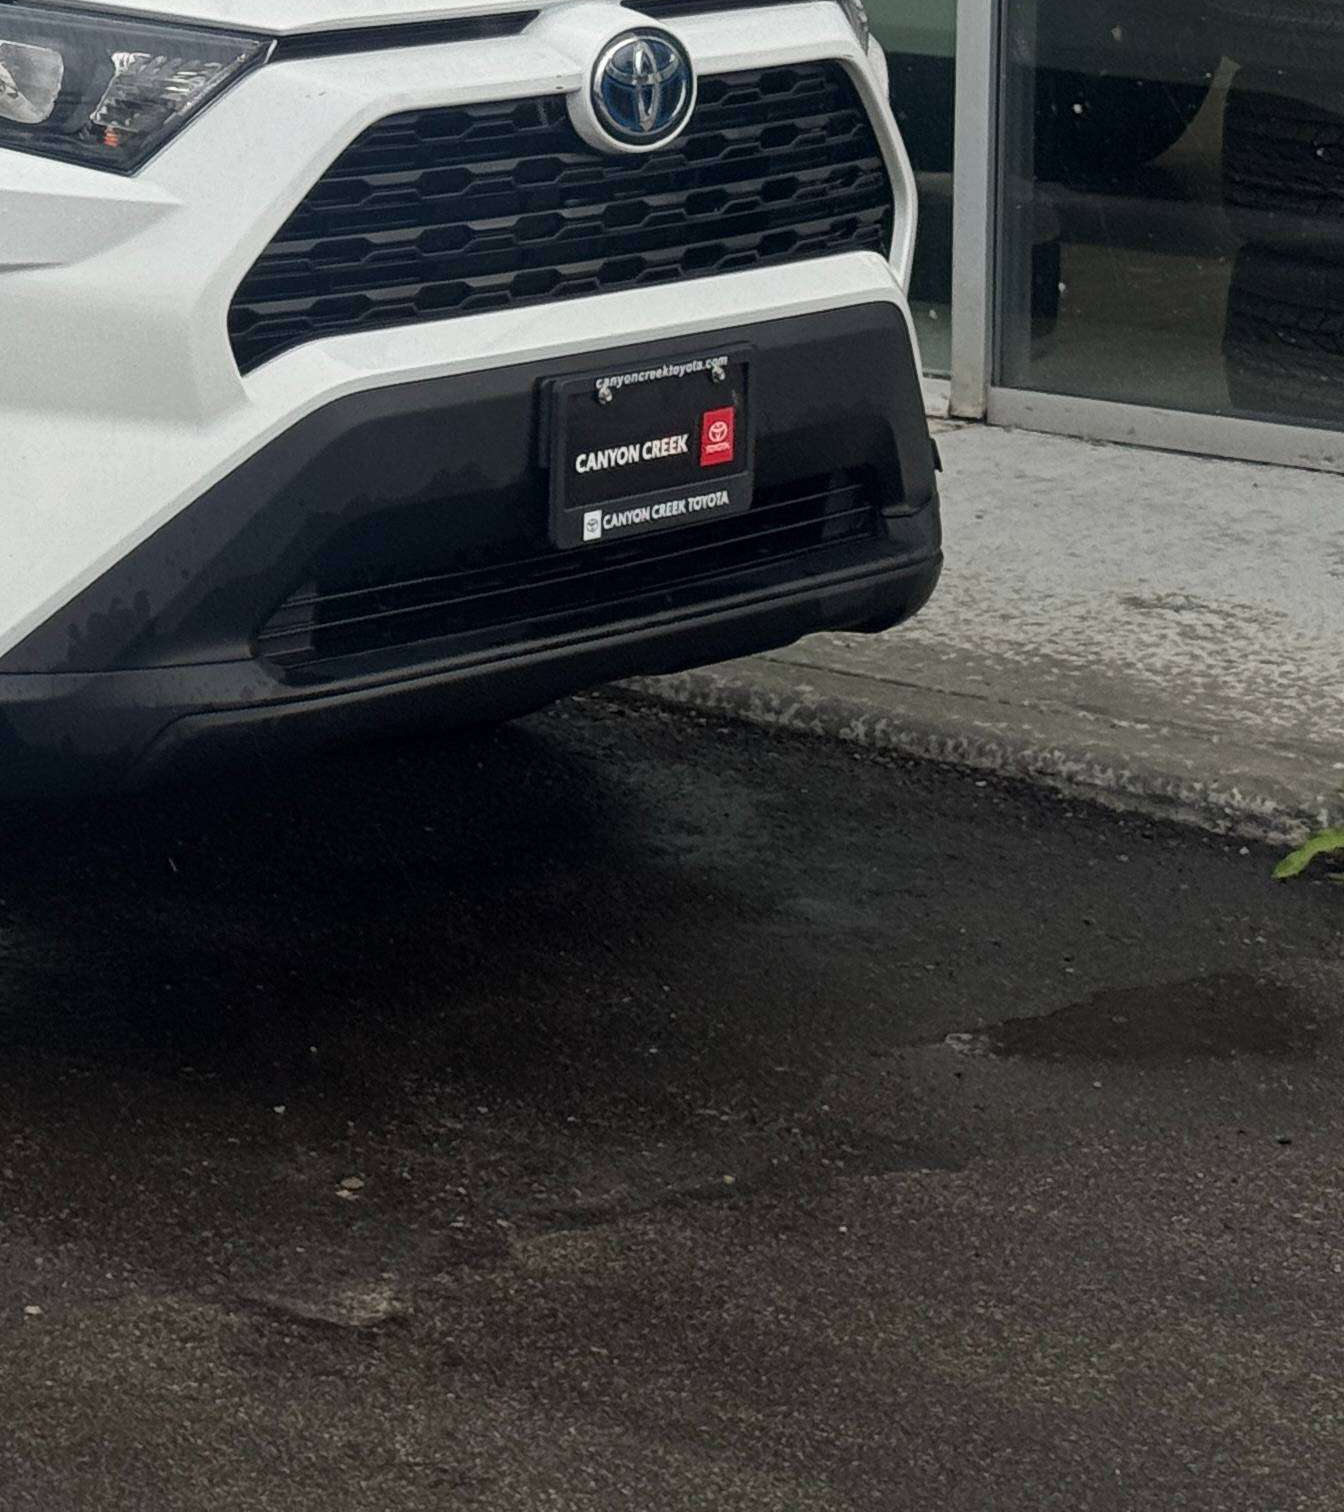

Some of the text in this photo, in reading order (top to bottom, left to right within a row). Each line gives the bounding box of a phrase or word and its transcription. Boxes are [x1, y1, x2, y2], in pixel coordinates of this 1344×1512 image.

[596, 356, 729, 388] canyoncreektoyota.com
[575, 433, 689, 474] CANYON CREEK
[603, 490, 729, 530] CANYON CREEK TOYOTA
